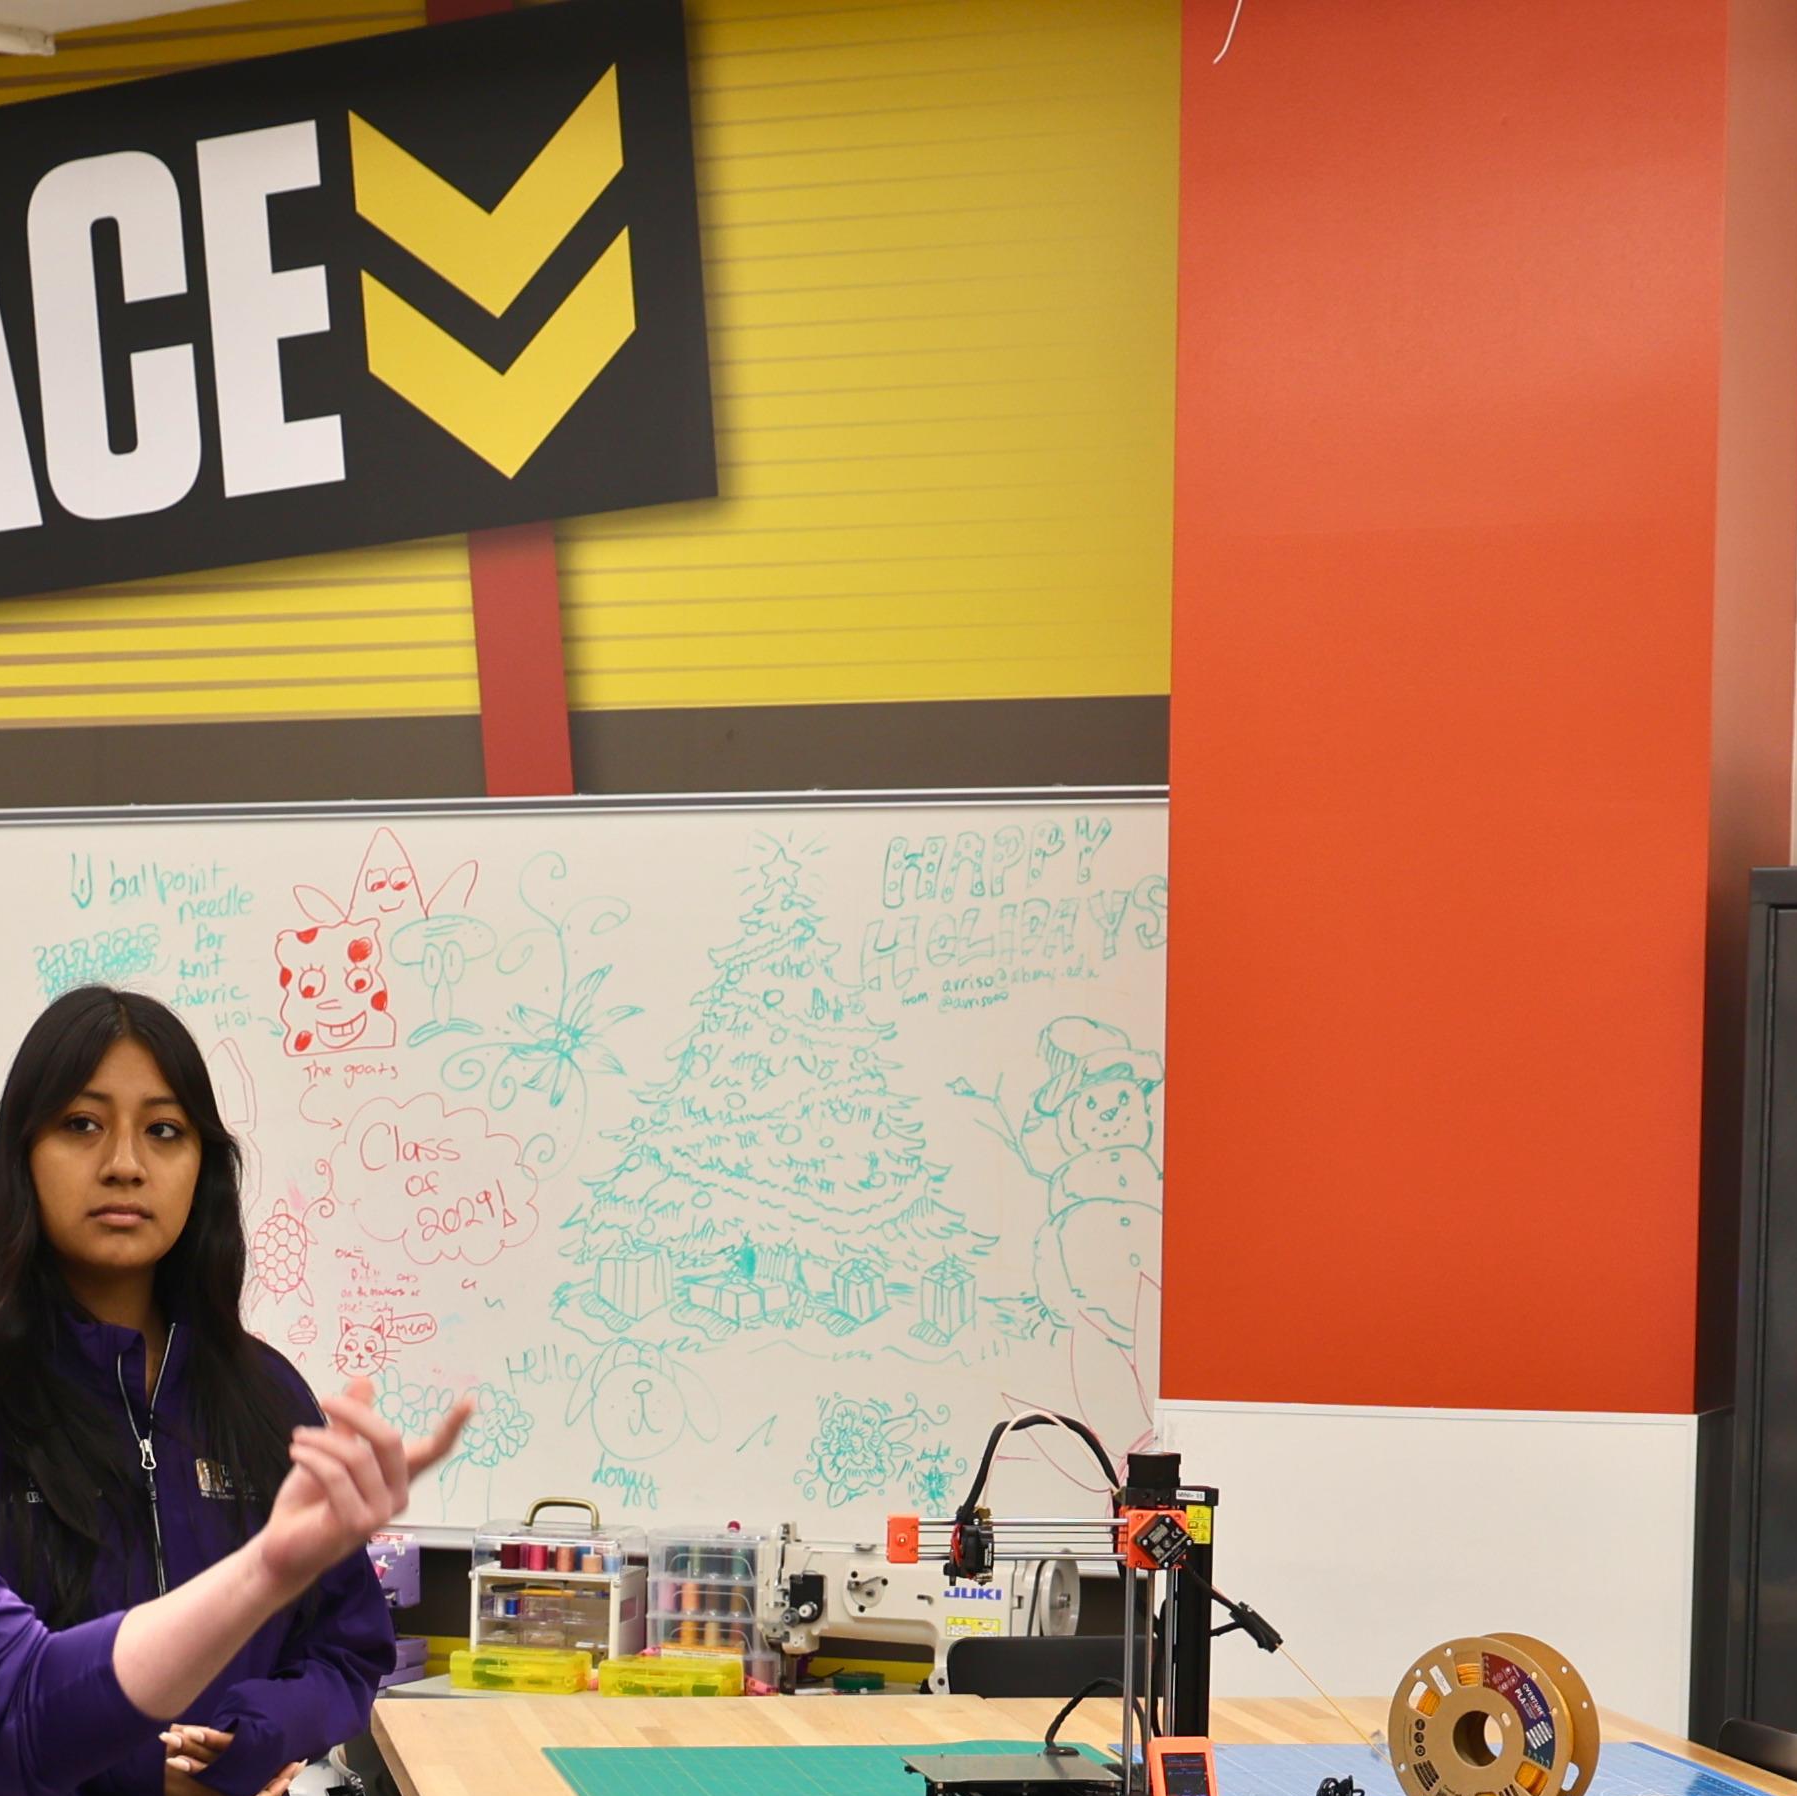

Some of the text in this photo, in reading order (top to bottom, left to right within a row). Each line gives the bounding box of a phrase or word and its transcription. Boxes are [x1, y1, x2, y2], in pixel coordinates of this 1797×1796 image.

[882, 815, 1112, 909] HAPPY
[178, 886, 254, 925] needle
[194, 924, 226, 952] for
[170, 983, 250, 1010] fabric
[344, 1062, 399, 1089] goats
[359, 1121, 461, 1172] Class
[404, 1170, 440, 1198] of
[943, 1586, 1003, 1601] JUKI
[1514, 1687, 1526, 1706] PLA
